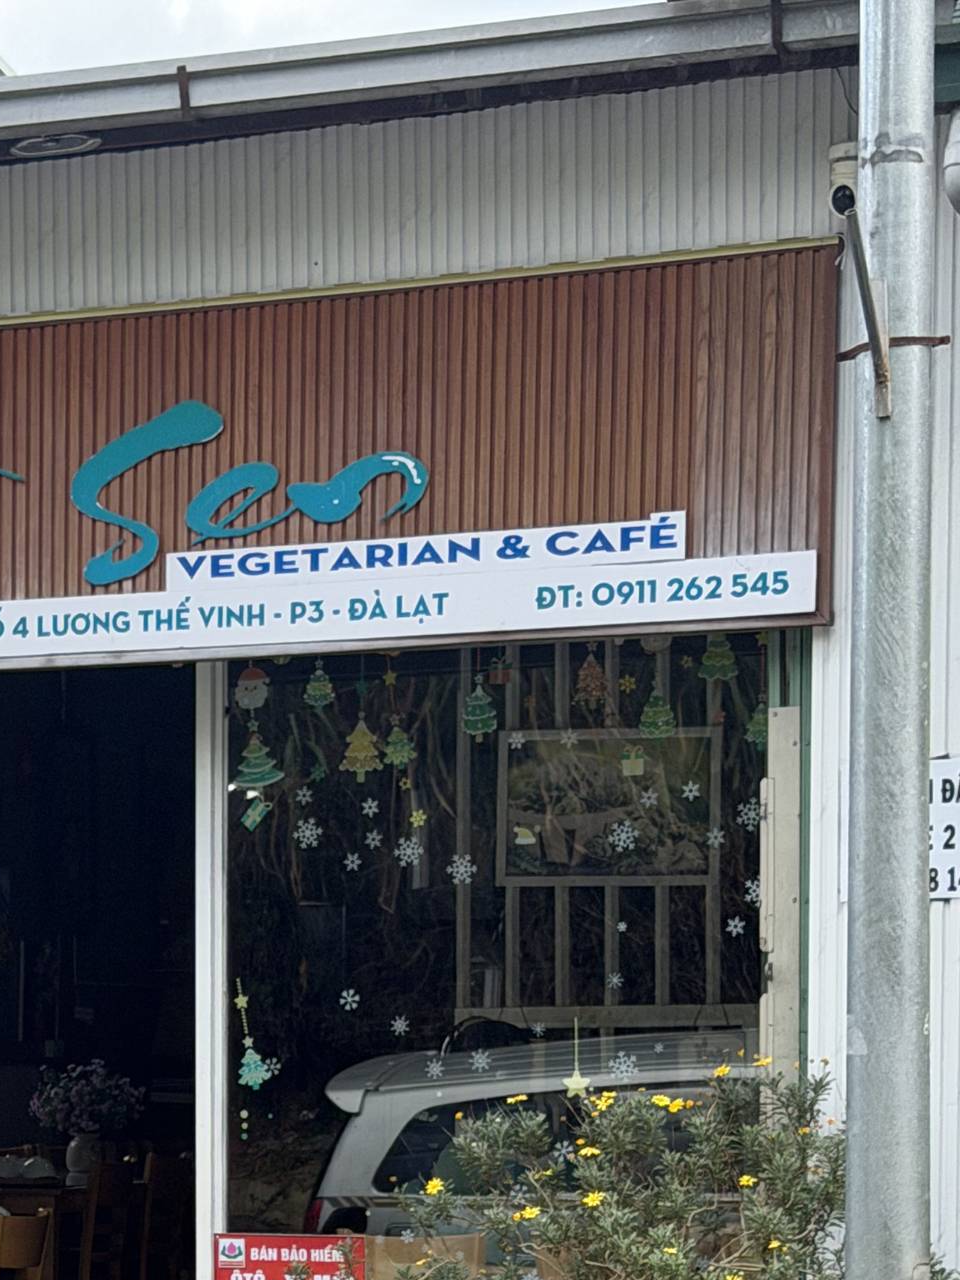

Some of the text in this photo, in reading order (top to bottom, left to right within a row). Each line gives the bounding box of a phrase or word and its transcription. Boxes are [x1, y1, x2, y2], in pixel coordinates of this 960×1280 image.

[71, 400, 430, 587] Sen
[176, 516, 678, 580] VEGETARIAN & CAFÉ
[535, 570, 790, 610] ĐT: 0911 262 545
[12, 617, 30, 639] 4
[37, 610, 131, 638] LƯƠNG
[138, 596, 191, 633] THẾ
[197, 603, 265, 629] VINH
[290, 599, 325, 625] P3
[348, 589, 388, 622] ĐÀ
[395, 592, 450, 625] LẠT
[940, 773, 960, 804] Đ
[250, 1244, 278, 1262] BÁN
